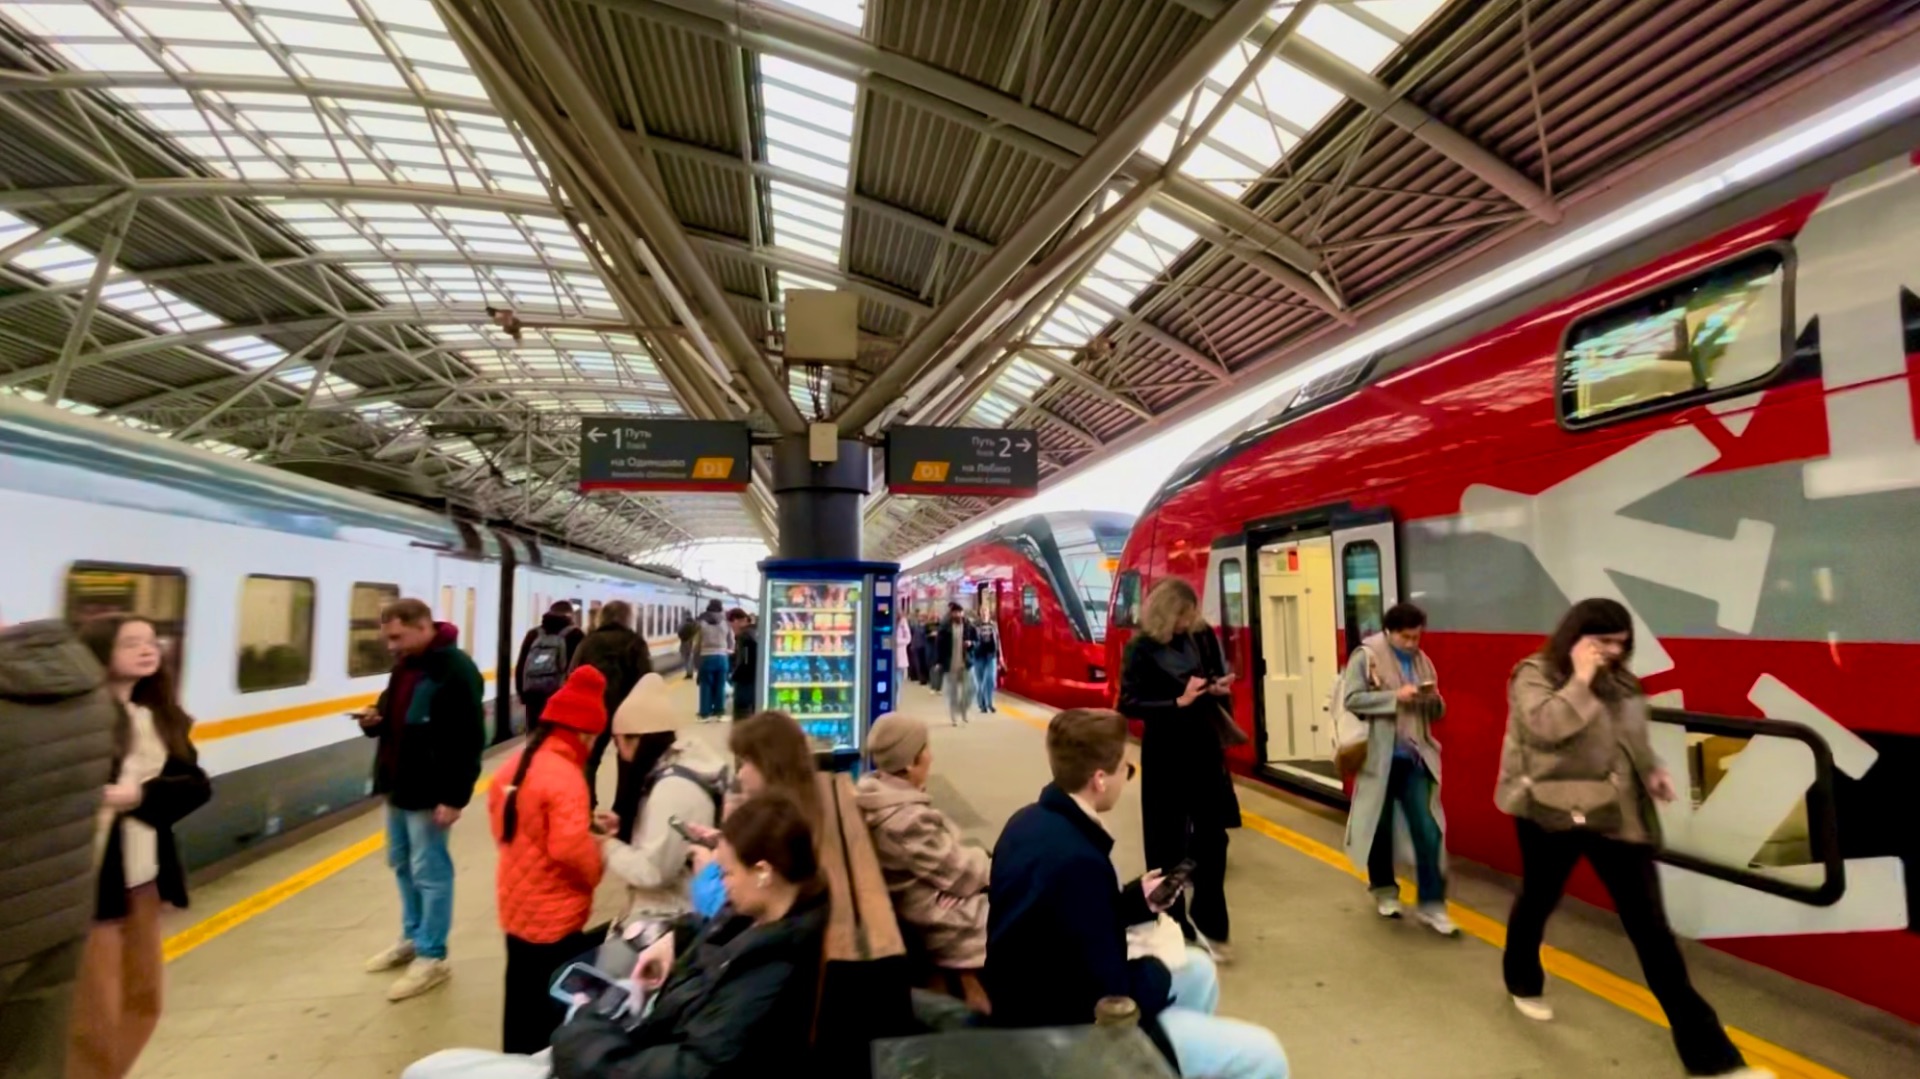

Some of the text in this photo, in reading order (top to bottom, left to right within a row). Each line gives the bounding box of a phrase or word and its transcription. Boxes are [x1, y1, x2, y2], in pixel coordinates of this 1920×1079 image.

[612, 428, 651, 449] 1 Путь
[972, 437, 995, 448] Путь
[998, 437, 1012, 458] 2
[703, 462, 724, 475] D1
[921, 466, 941, 478] D1
